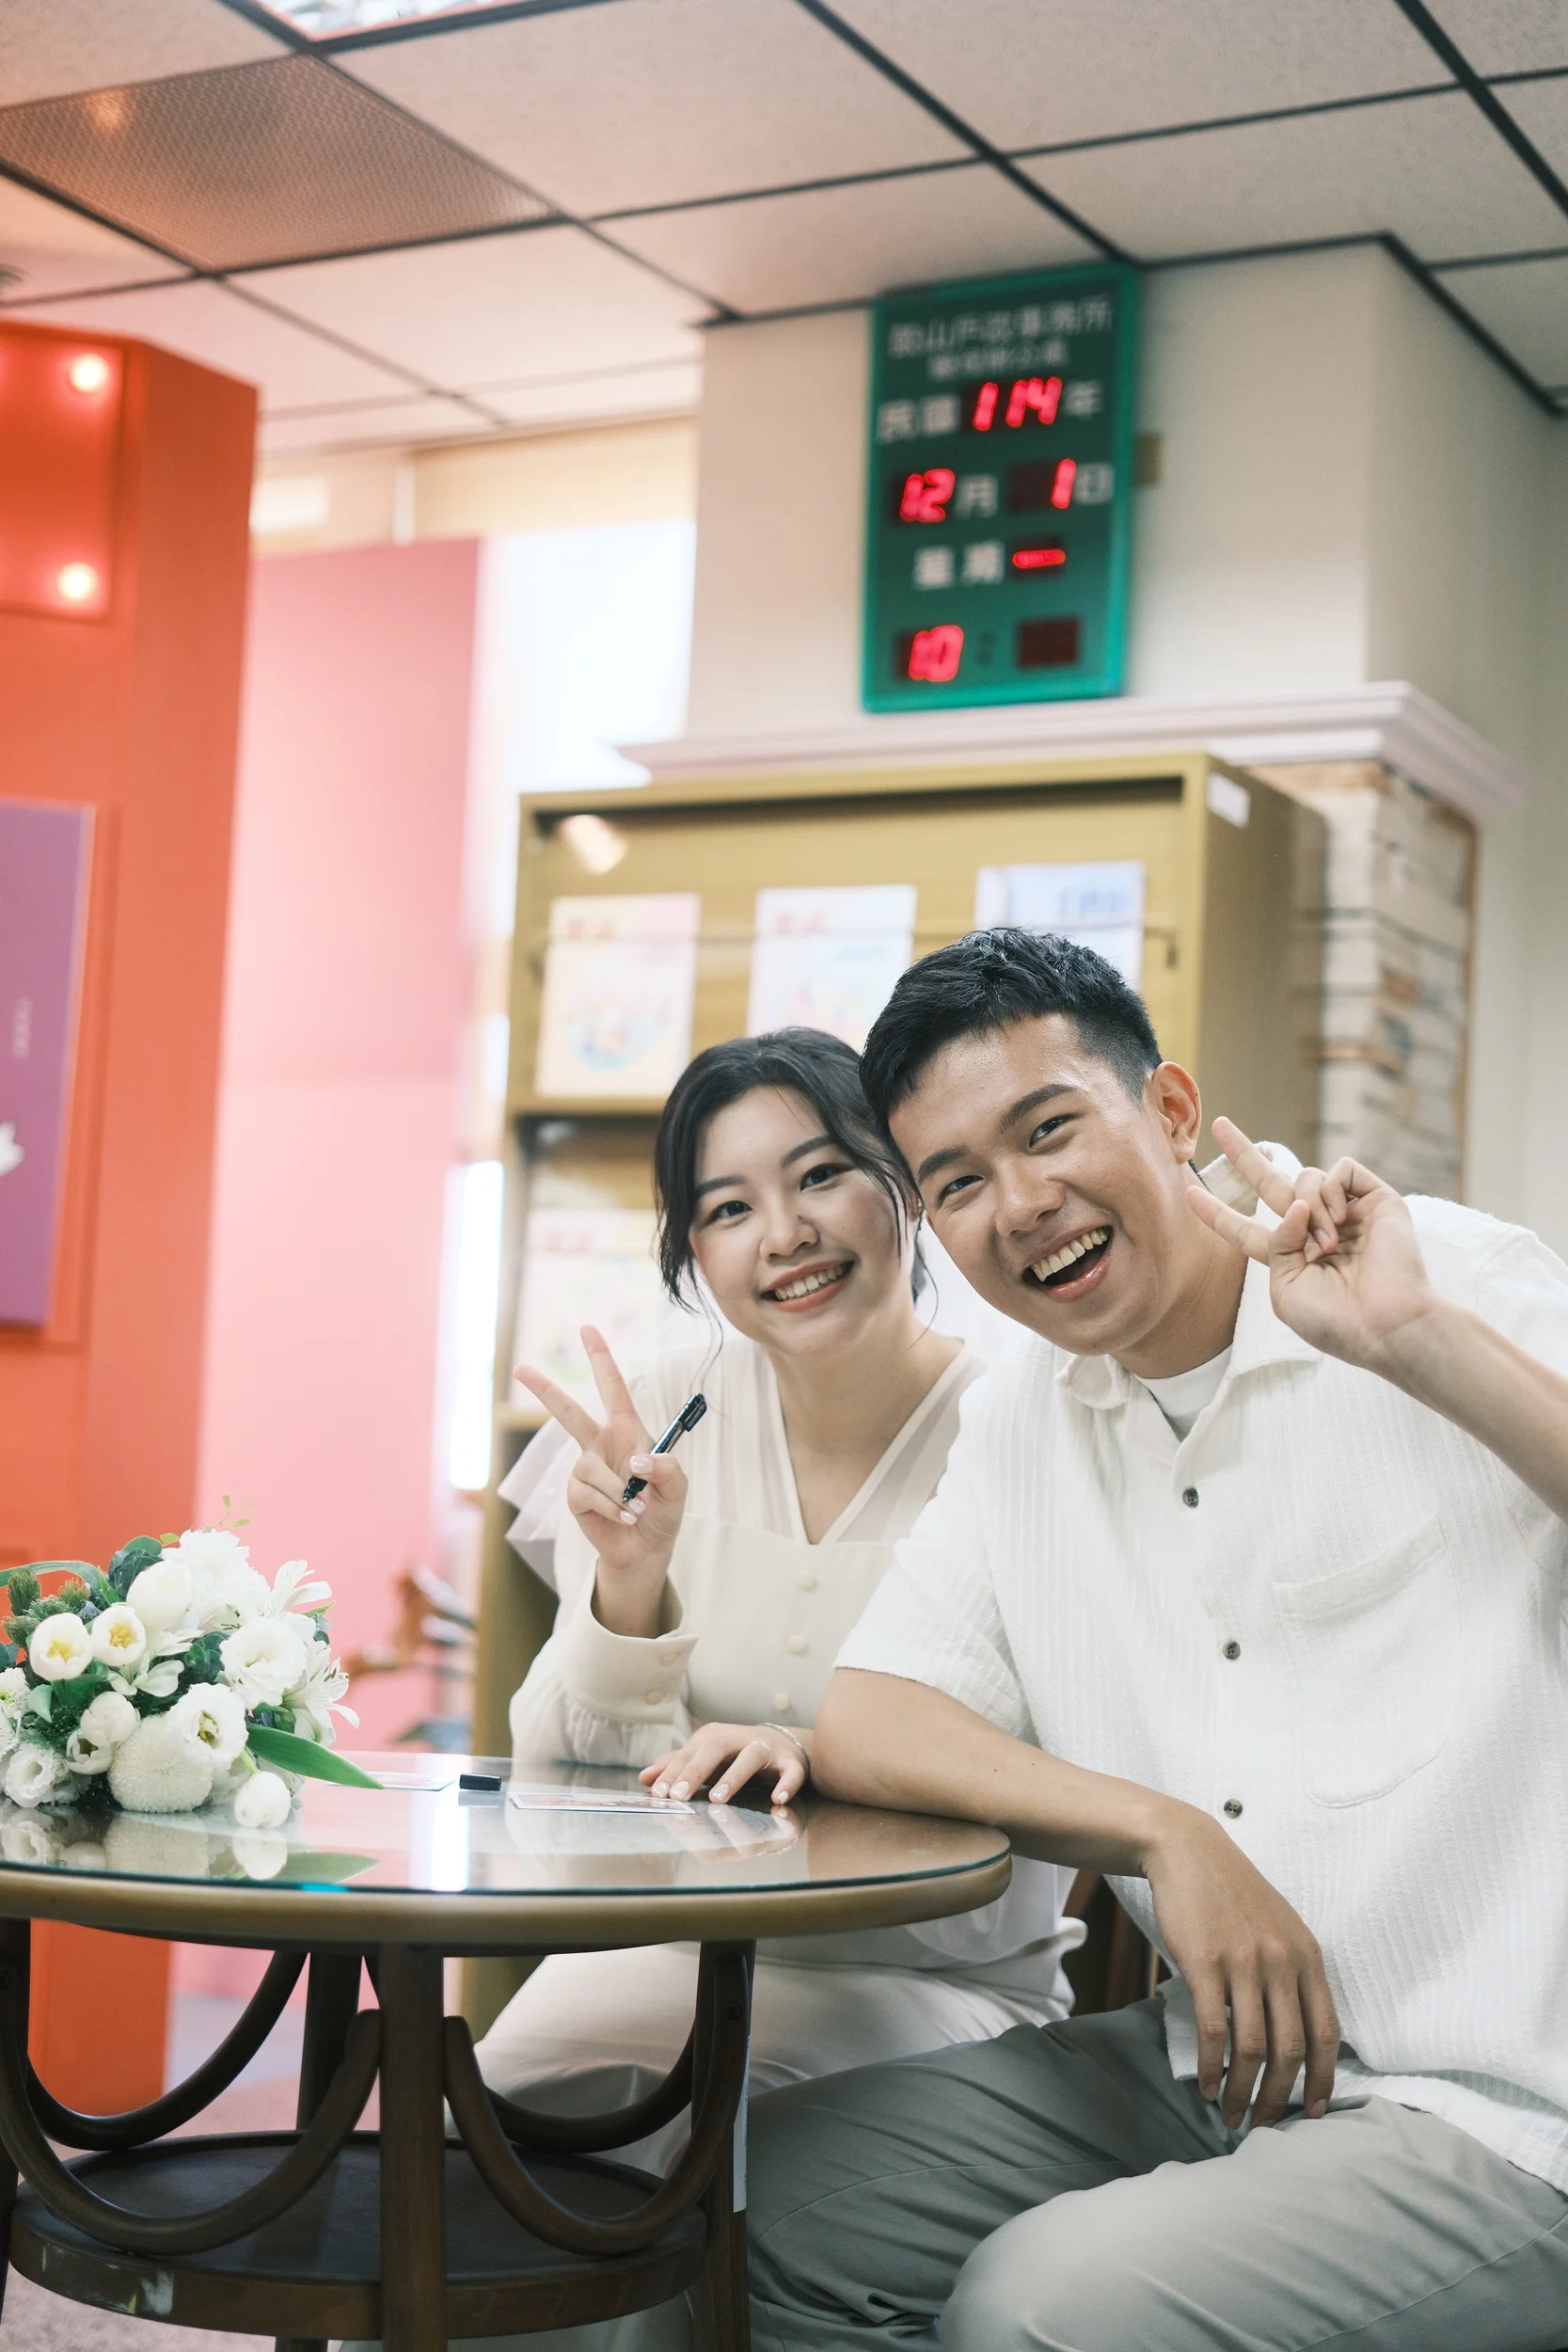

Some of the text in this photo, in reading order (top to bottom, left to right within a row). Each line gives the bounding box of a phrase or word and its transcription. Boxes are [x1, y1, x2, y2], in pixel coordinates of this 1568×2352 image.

[973, 376, 1062, 431] 114
[900, 458, 1114, 522] 12 月 1 日
[909, 625, 963, 681] 10
